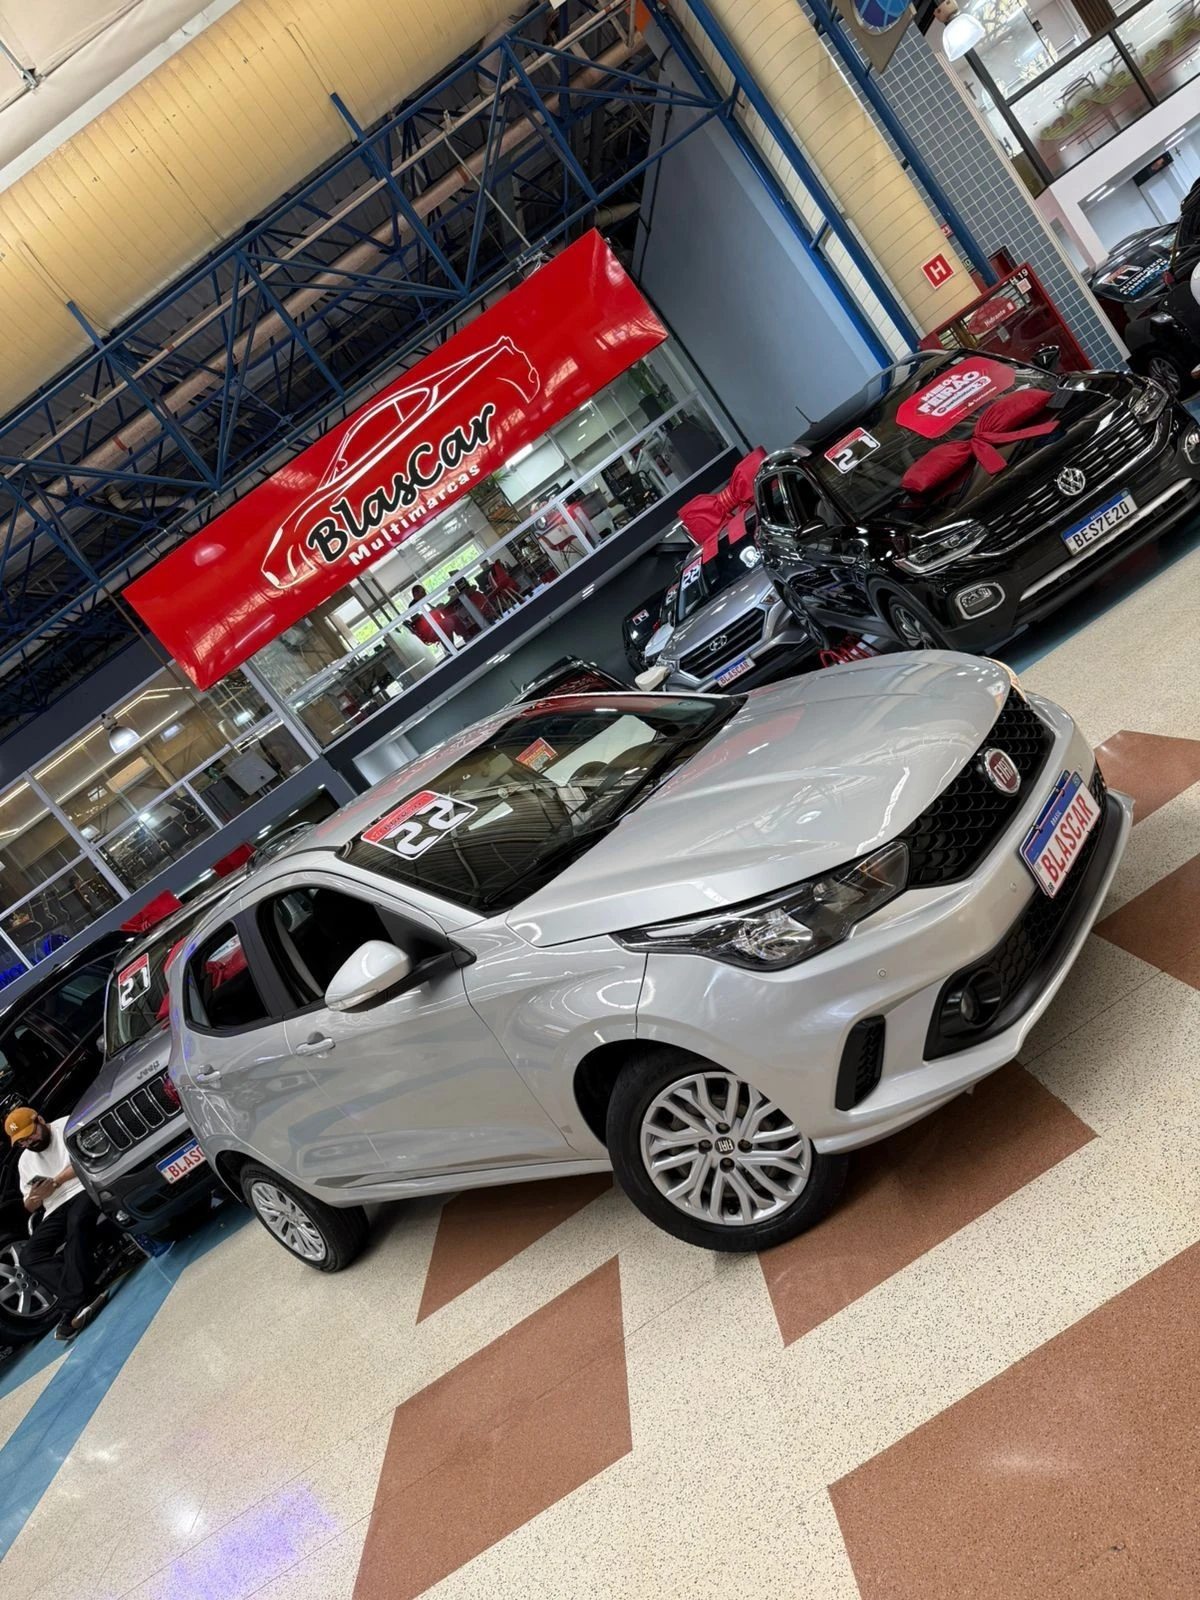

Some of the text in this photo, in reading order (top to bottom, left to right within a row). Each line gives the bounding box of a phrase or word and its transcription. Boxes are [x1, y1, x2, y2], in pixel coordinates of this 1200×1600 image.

[929, 260, 947, 281] H
[1009, 275, 1018, 286] H
[1018, 269, 1029, 281] 19
[917, 370, 980, 413] FEIRÃO
[920, 374, 962, 402] MEGA
[306, 403, 496, 563] BlasCar
[348, 464, 481, 566] Multimarcas
[1072, 500, 1130, 548] BES7E20
[720, 662, 750, 685] BLASCAR
[993, 757, 1016, 785] FIAT
[383, 799, 470, 855] 22
[1050, 811, 1062, 828] BRASIL
[1041, 793, 1094, 883] BLASCAR
[122, 966, 148, 1007] 21
[137, 1060, 160, 1080] Jeep
[717, 1139, 734, 1152] FIAT
